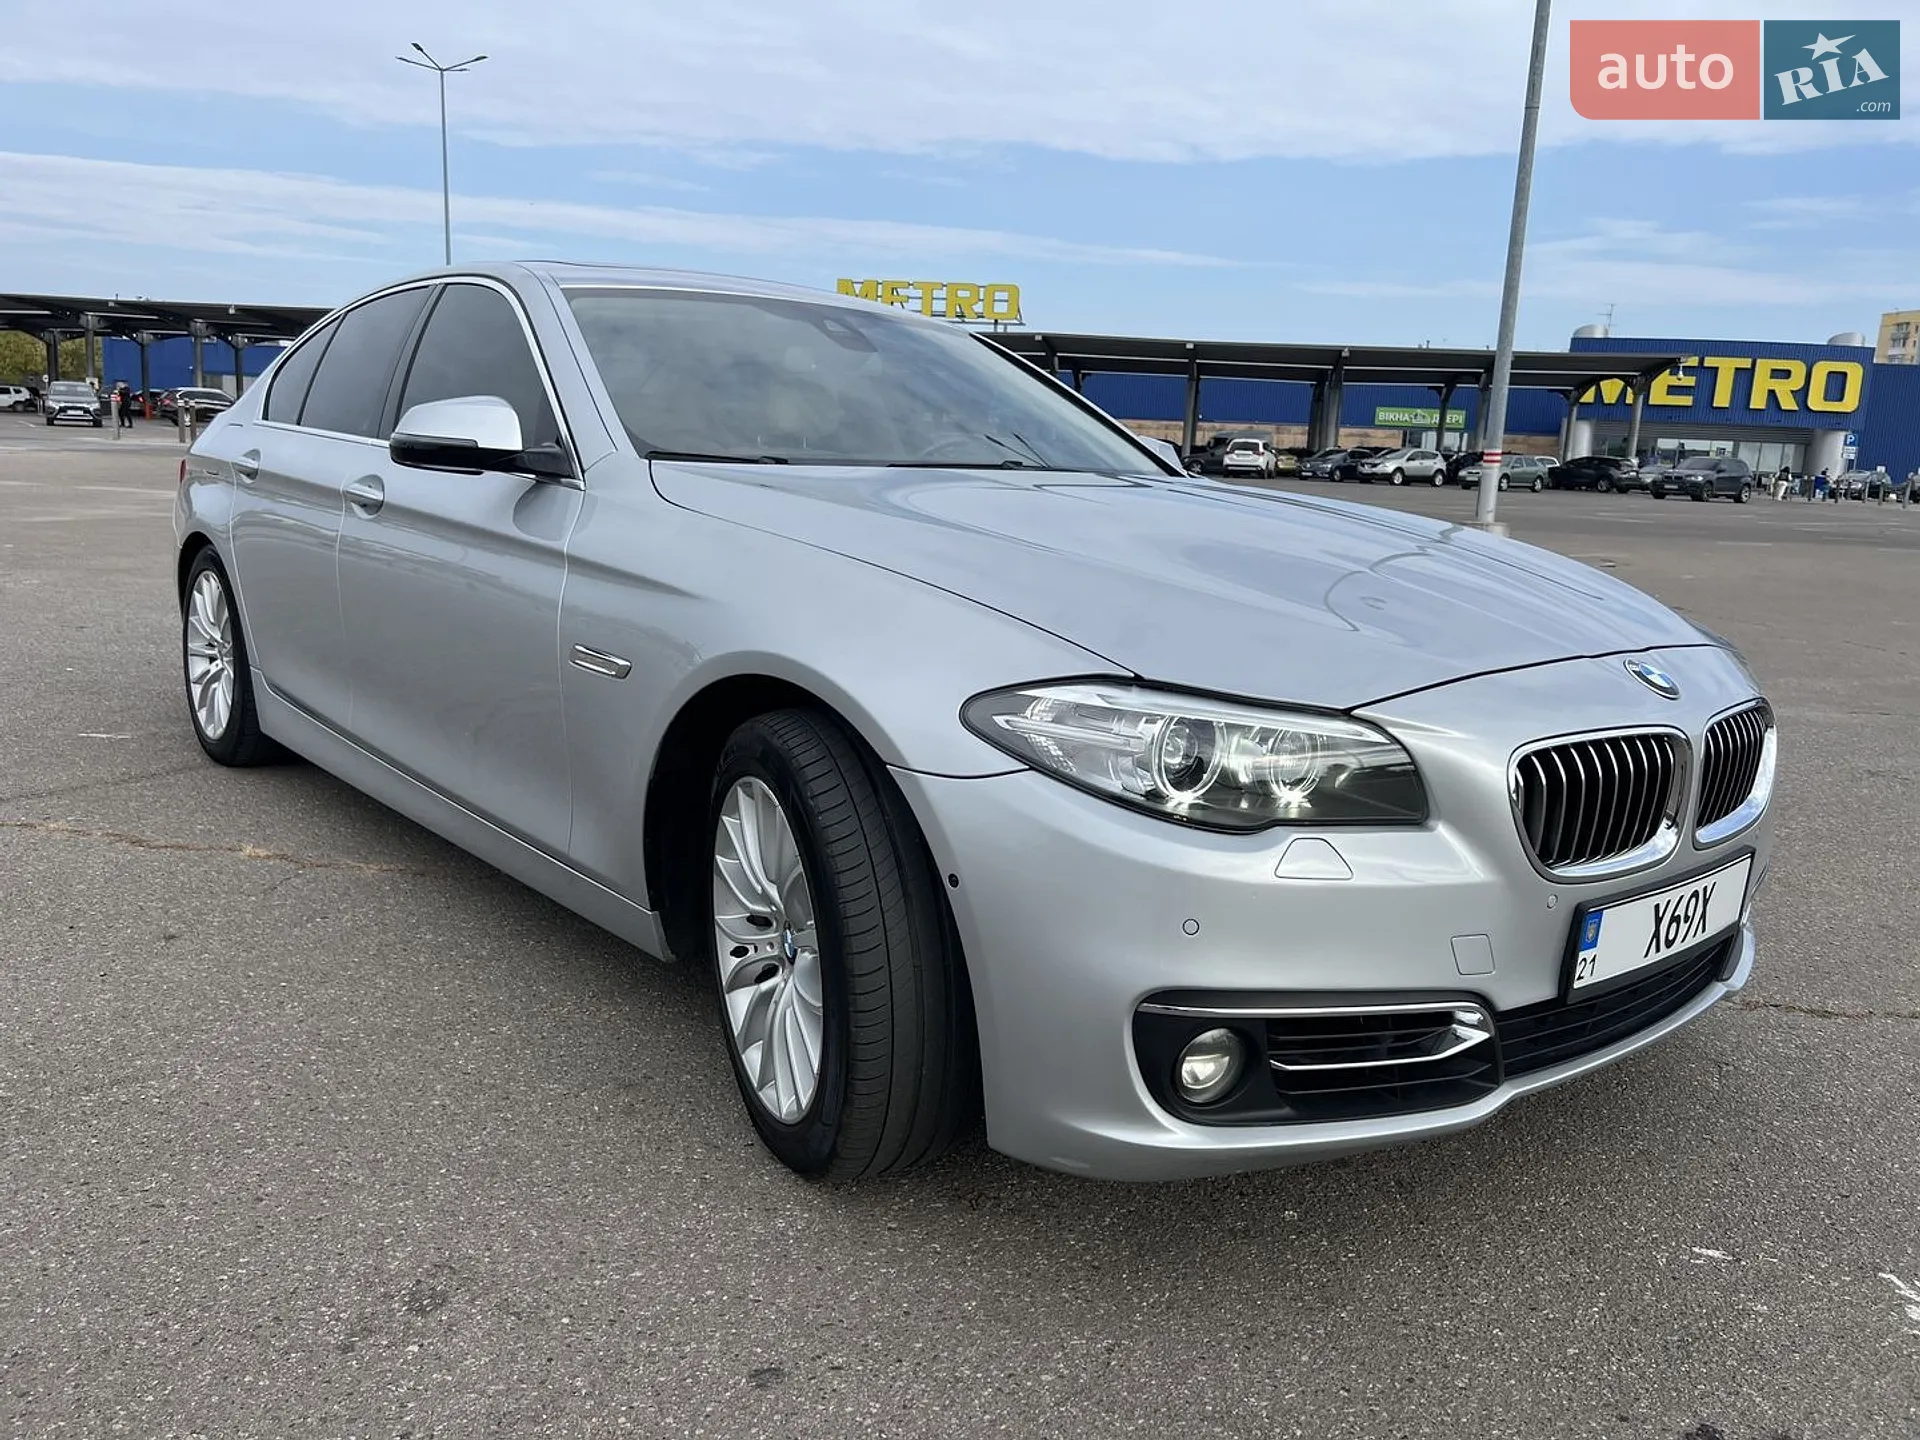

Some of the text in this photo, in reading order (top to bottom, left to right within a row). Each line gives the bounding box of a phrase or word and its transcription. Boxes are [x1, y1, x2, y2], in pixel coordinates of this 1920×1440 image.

[1378, 412, 1463, 424] ВІКНА ДЕРІ
[1846, 434, 1855, 445] P
[1644, 881, 1717, 959] X69X
[1576, 953, 1597, 982] 21
